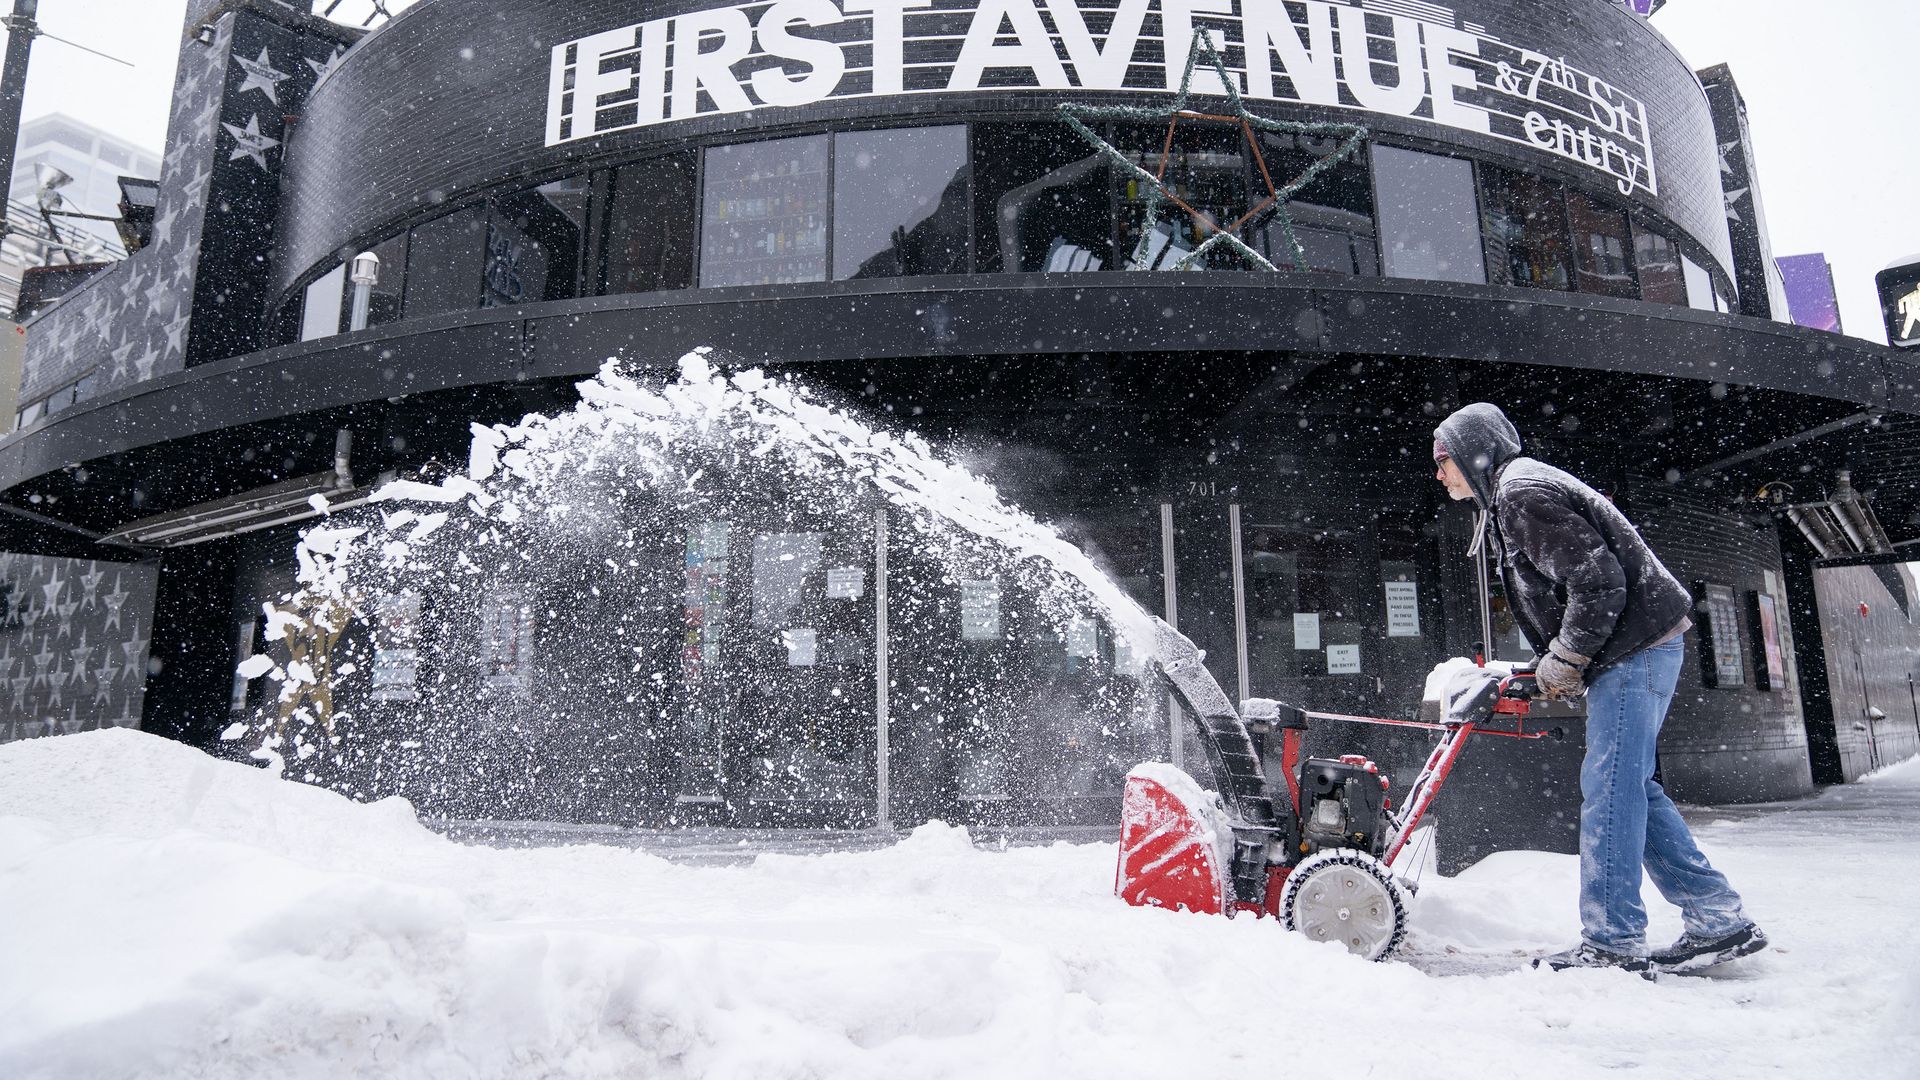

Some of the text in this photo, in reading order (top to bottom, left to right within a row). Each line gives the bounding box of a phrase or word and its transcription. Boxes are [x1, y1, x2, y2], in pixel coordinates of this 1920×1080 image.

[570, 0, 1491, 135] FIRST AVENUE
[1588, 76, 1636, 142] St
[1524, 111, 1642, 196] entry
[1189, 481, 1216, 496] 701
